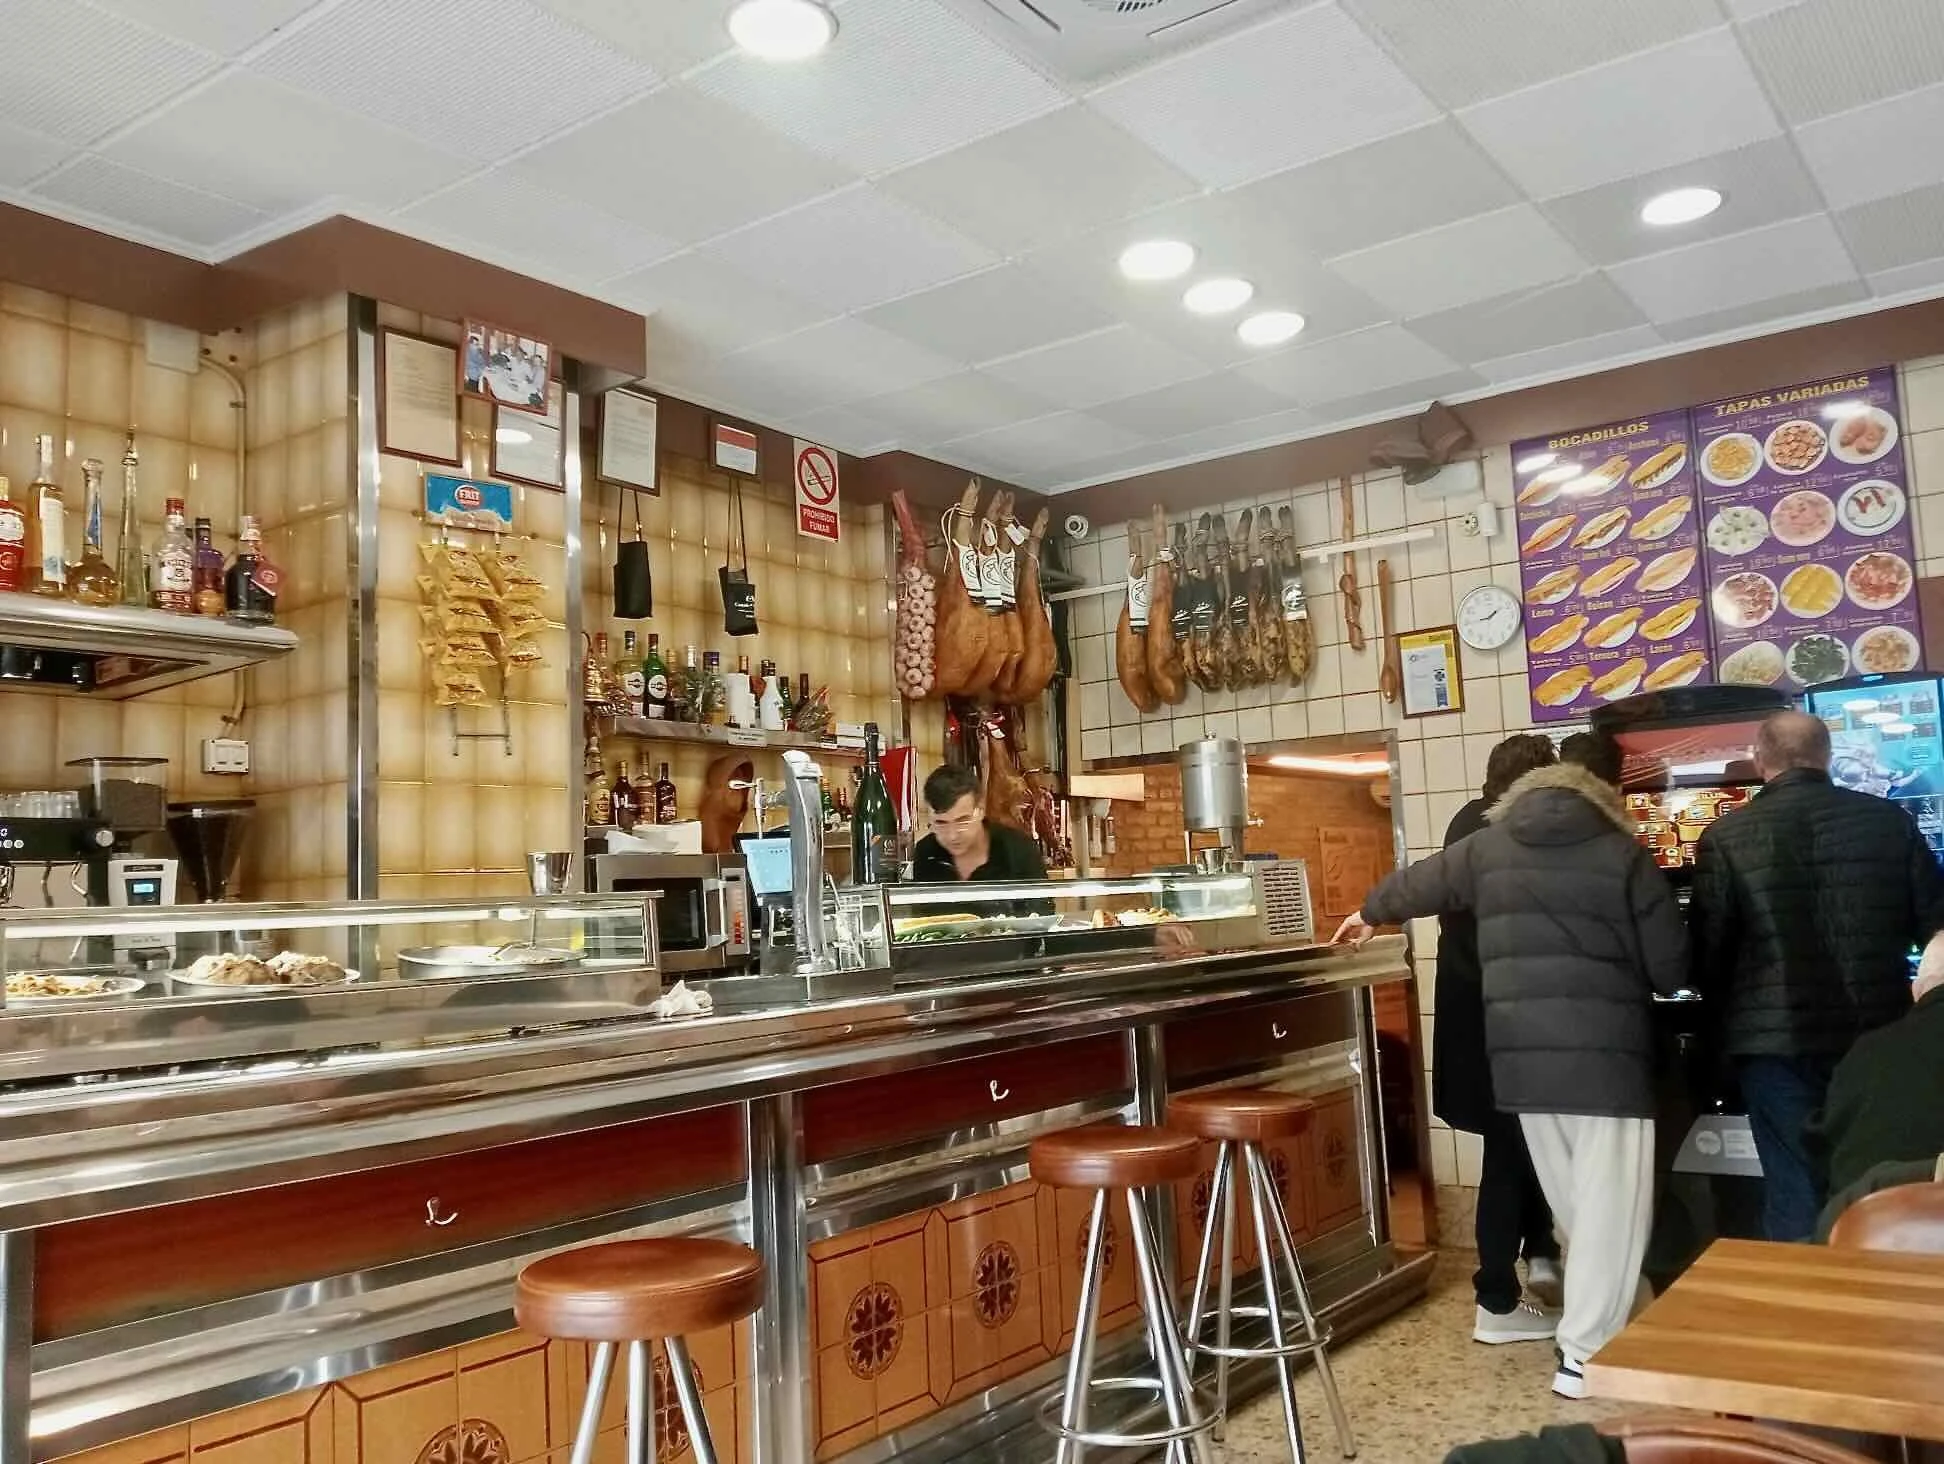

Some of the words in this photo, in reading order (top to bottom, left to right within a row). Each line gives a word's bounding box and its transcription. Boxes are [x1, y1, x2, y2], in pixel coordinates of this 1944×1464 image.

[1715, 396, 1771, 416] TAPAS
[1777, 376, 1870, 403] VARIADAS
[1548, 421, 1649, 449] BOCADILLOS
[803, 508, 835, 523] PROHIBIDO
[809, 521, 830, 533] FUMAR
